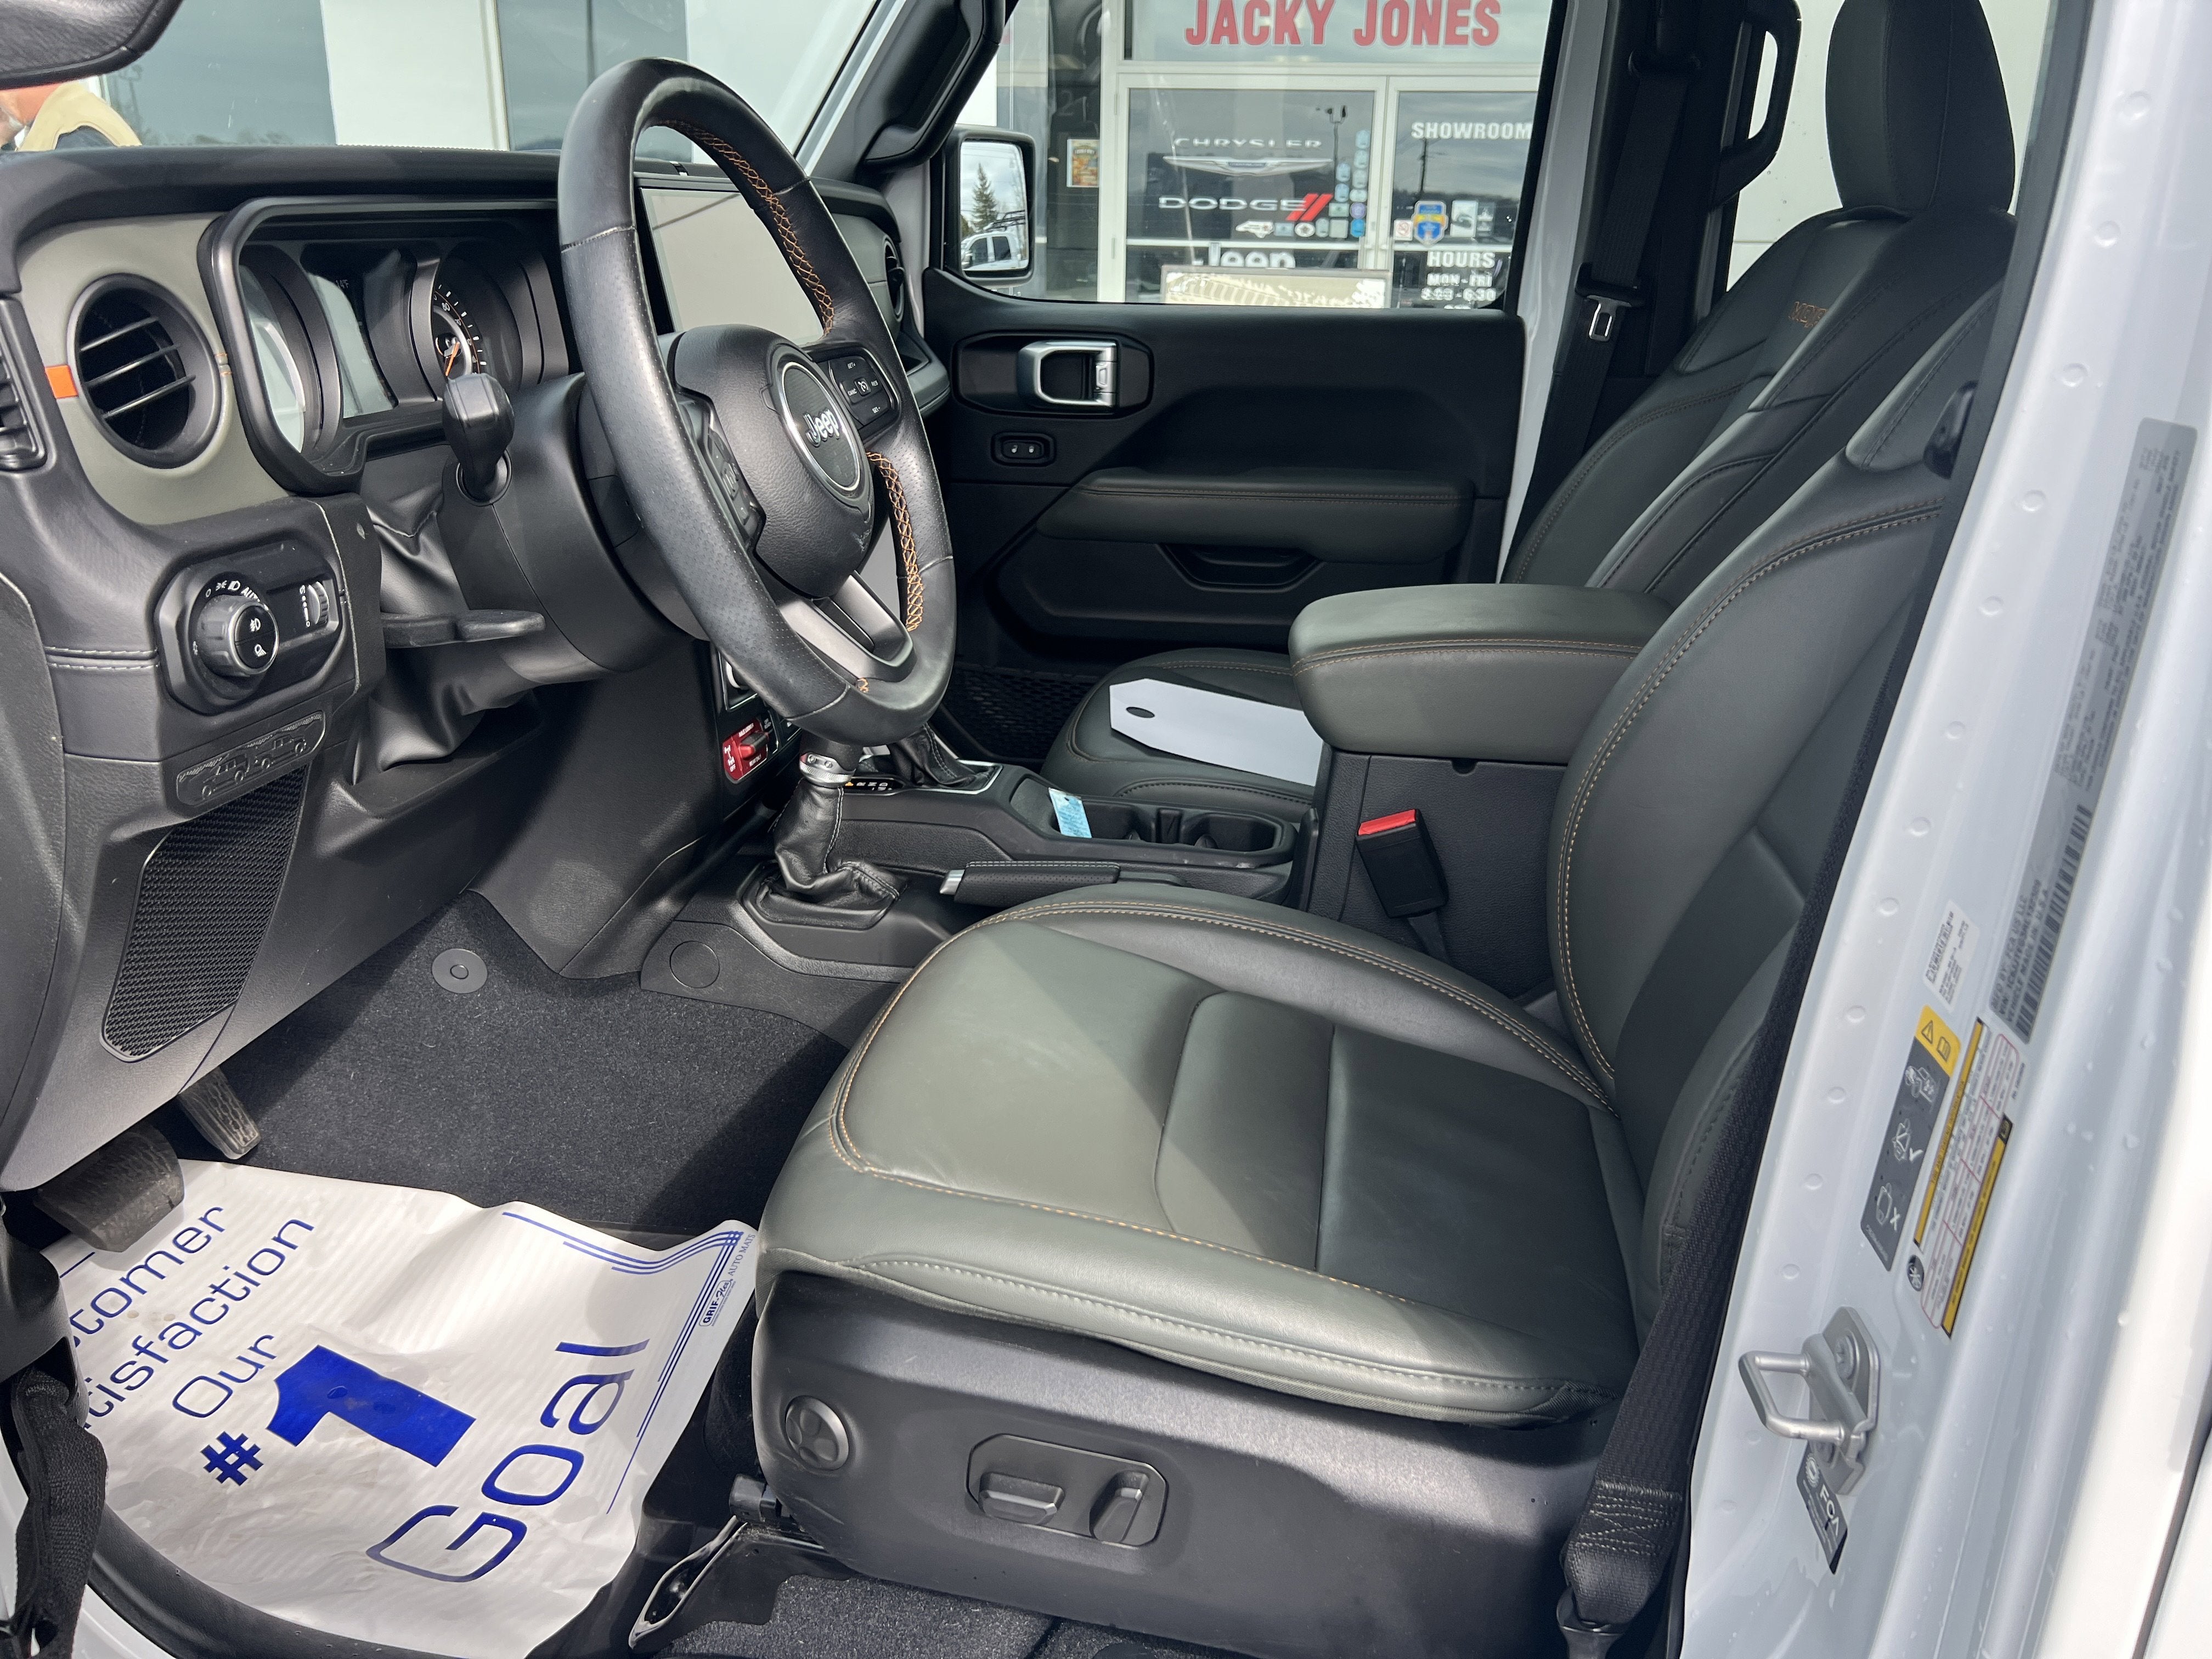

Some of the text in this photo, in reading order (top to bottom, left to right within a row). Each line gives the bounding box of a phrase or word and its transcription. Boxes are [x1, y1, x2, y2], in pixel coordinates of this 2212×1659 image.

[1184, 0, 1502, 46] JACKY JONES
[1411, 122, 1533, 140] SHOWROOM
[1159, 197, 1307, 211] DODGE
[1427, 251, 1496, 268] HOURS
[803, 409, 840, 447] Jeep
[727, 1254, 744, 1277] AUTO
[742, 1233, 756, 1254] MATS
[172, 1334, 277, 1419] Our
[365, 1338, 651, 1583] Goal
